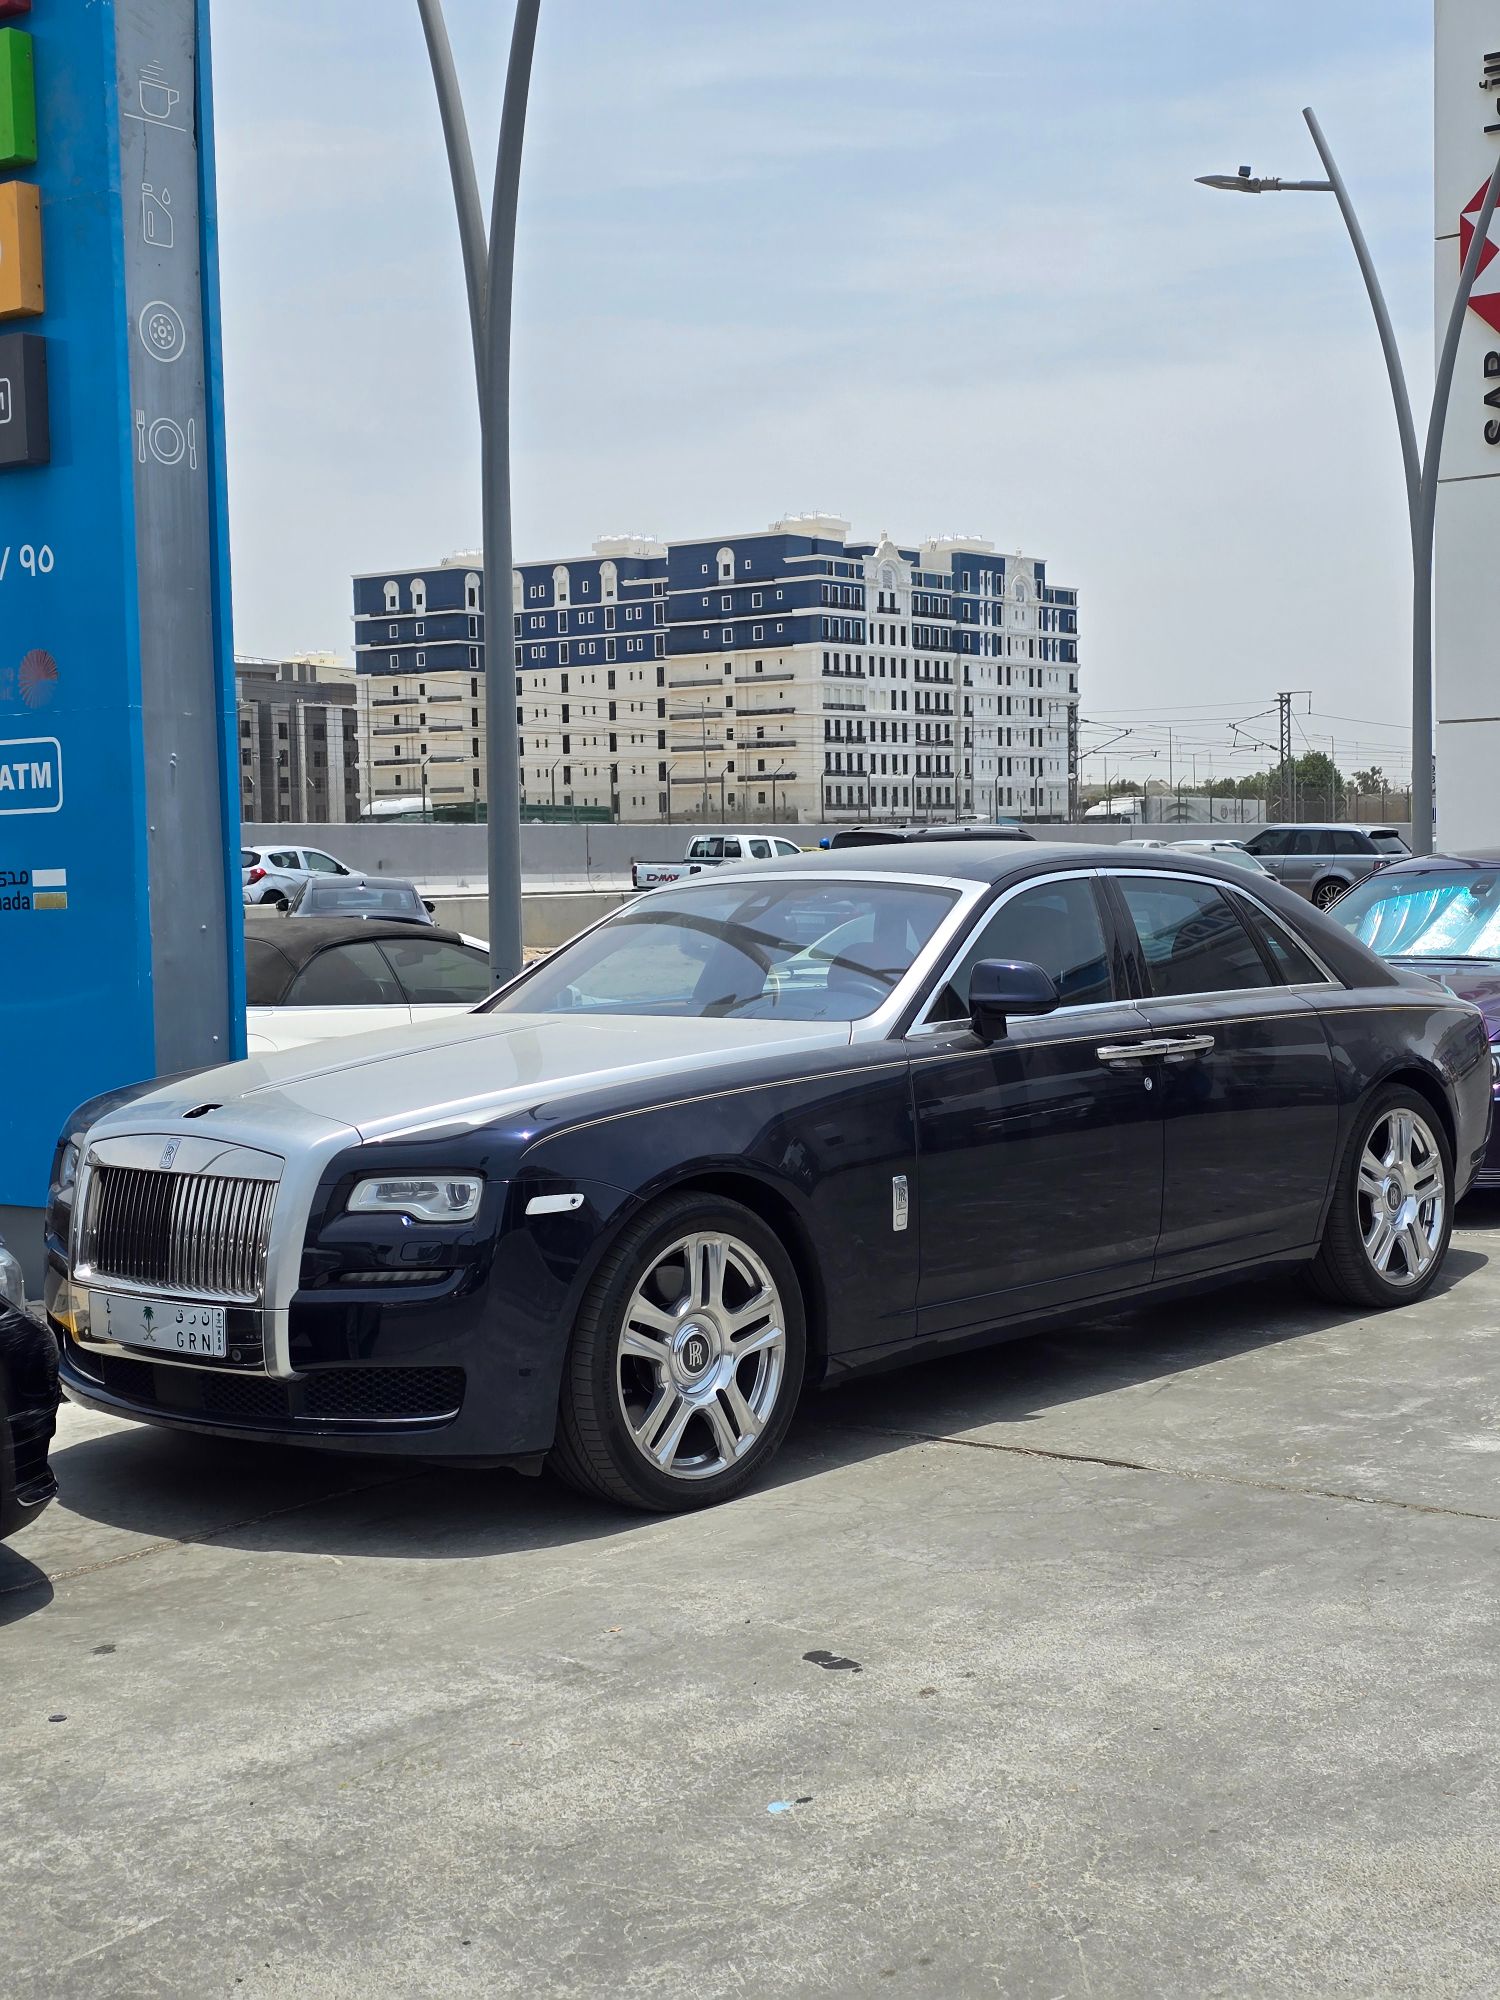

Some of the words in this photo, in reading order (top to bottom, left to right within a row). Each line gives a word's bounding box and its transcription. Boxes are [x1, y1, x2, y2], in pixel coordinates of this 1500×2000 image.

[0, 761, 52, 791] ATM
[0, 890, 30, 910] ada
[176, 1331, 211, 1352] GRN
